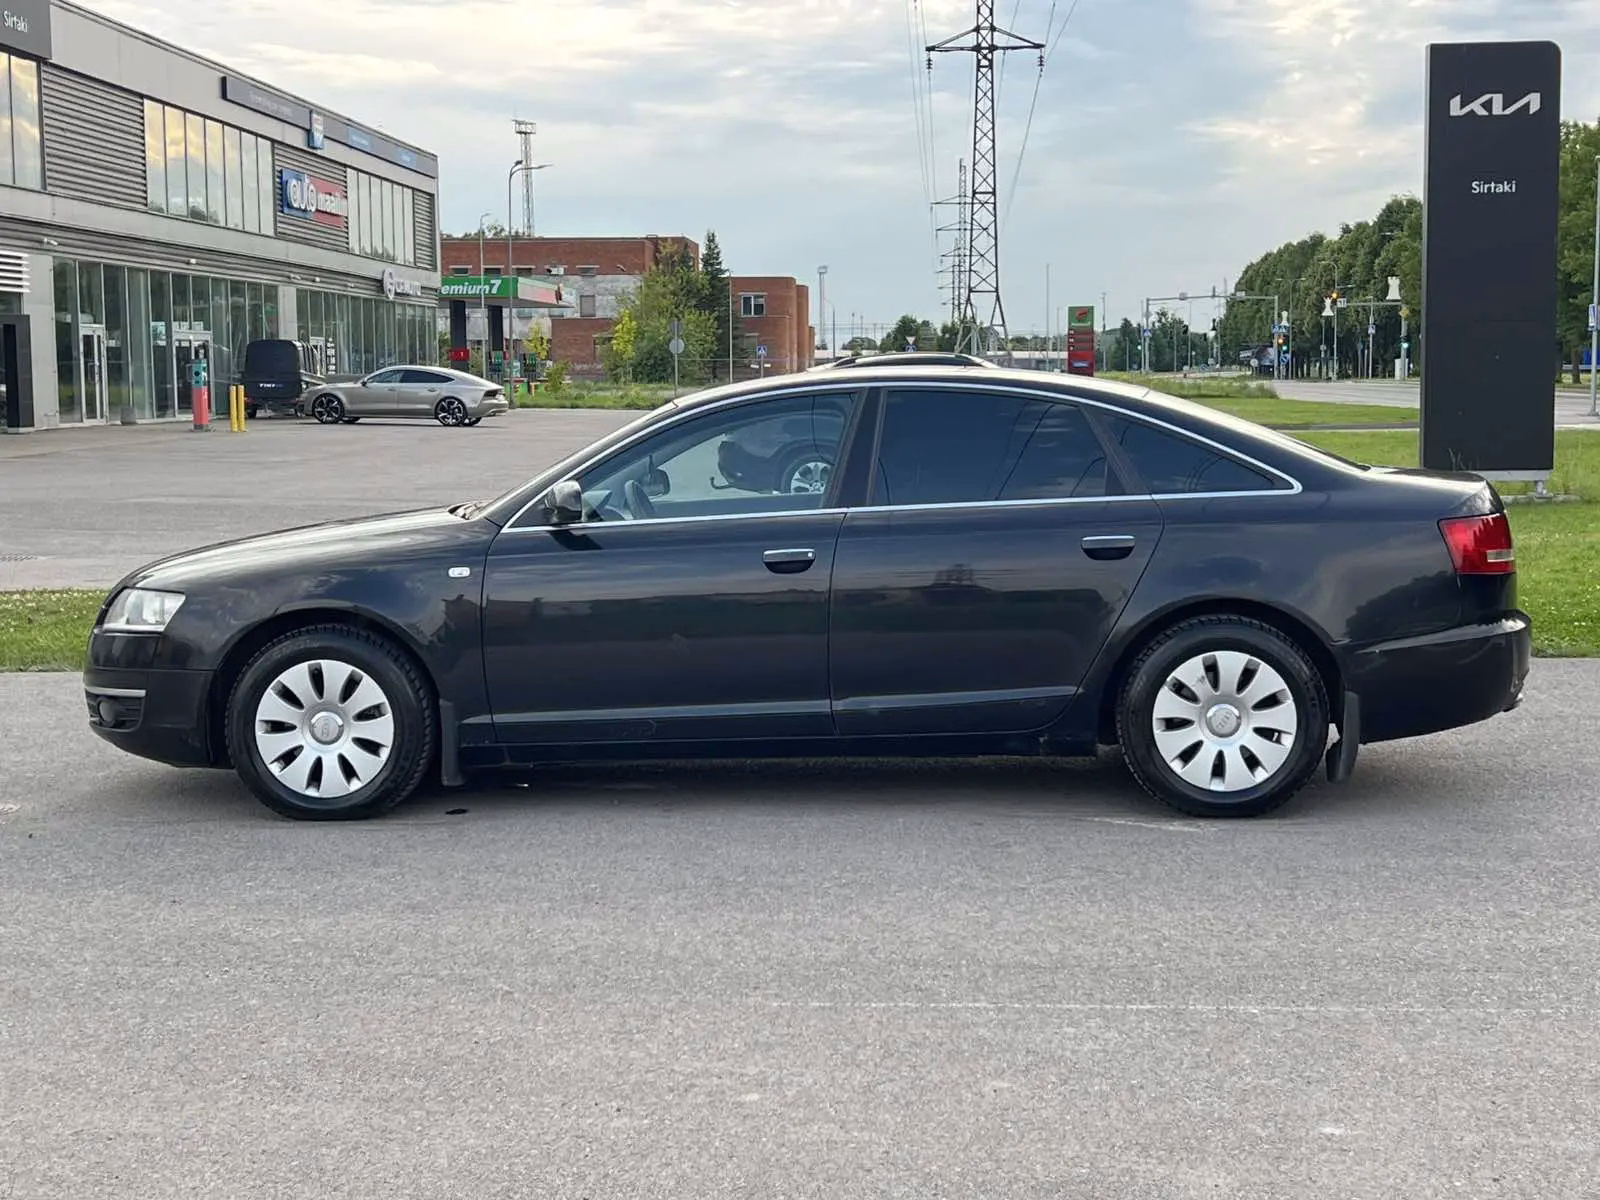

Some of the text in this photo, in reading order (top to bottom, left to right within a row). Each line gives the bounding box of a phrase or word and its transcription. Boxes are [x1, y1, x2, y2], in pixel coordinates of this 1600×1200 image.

[3, 9, 28, 33] Sirtaki
[1449, 92, 1541, 117] KIA
[1471, 180, 1516, 194] Sirtaki
